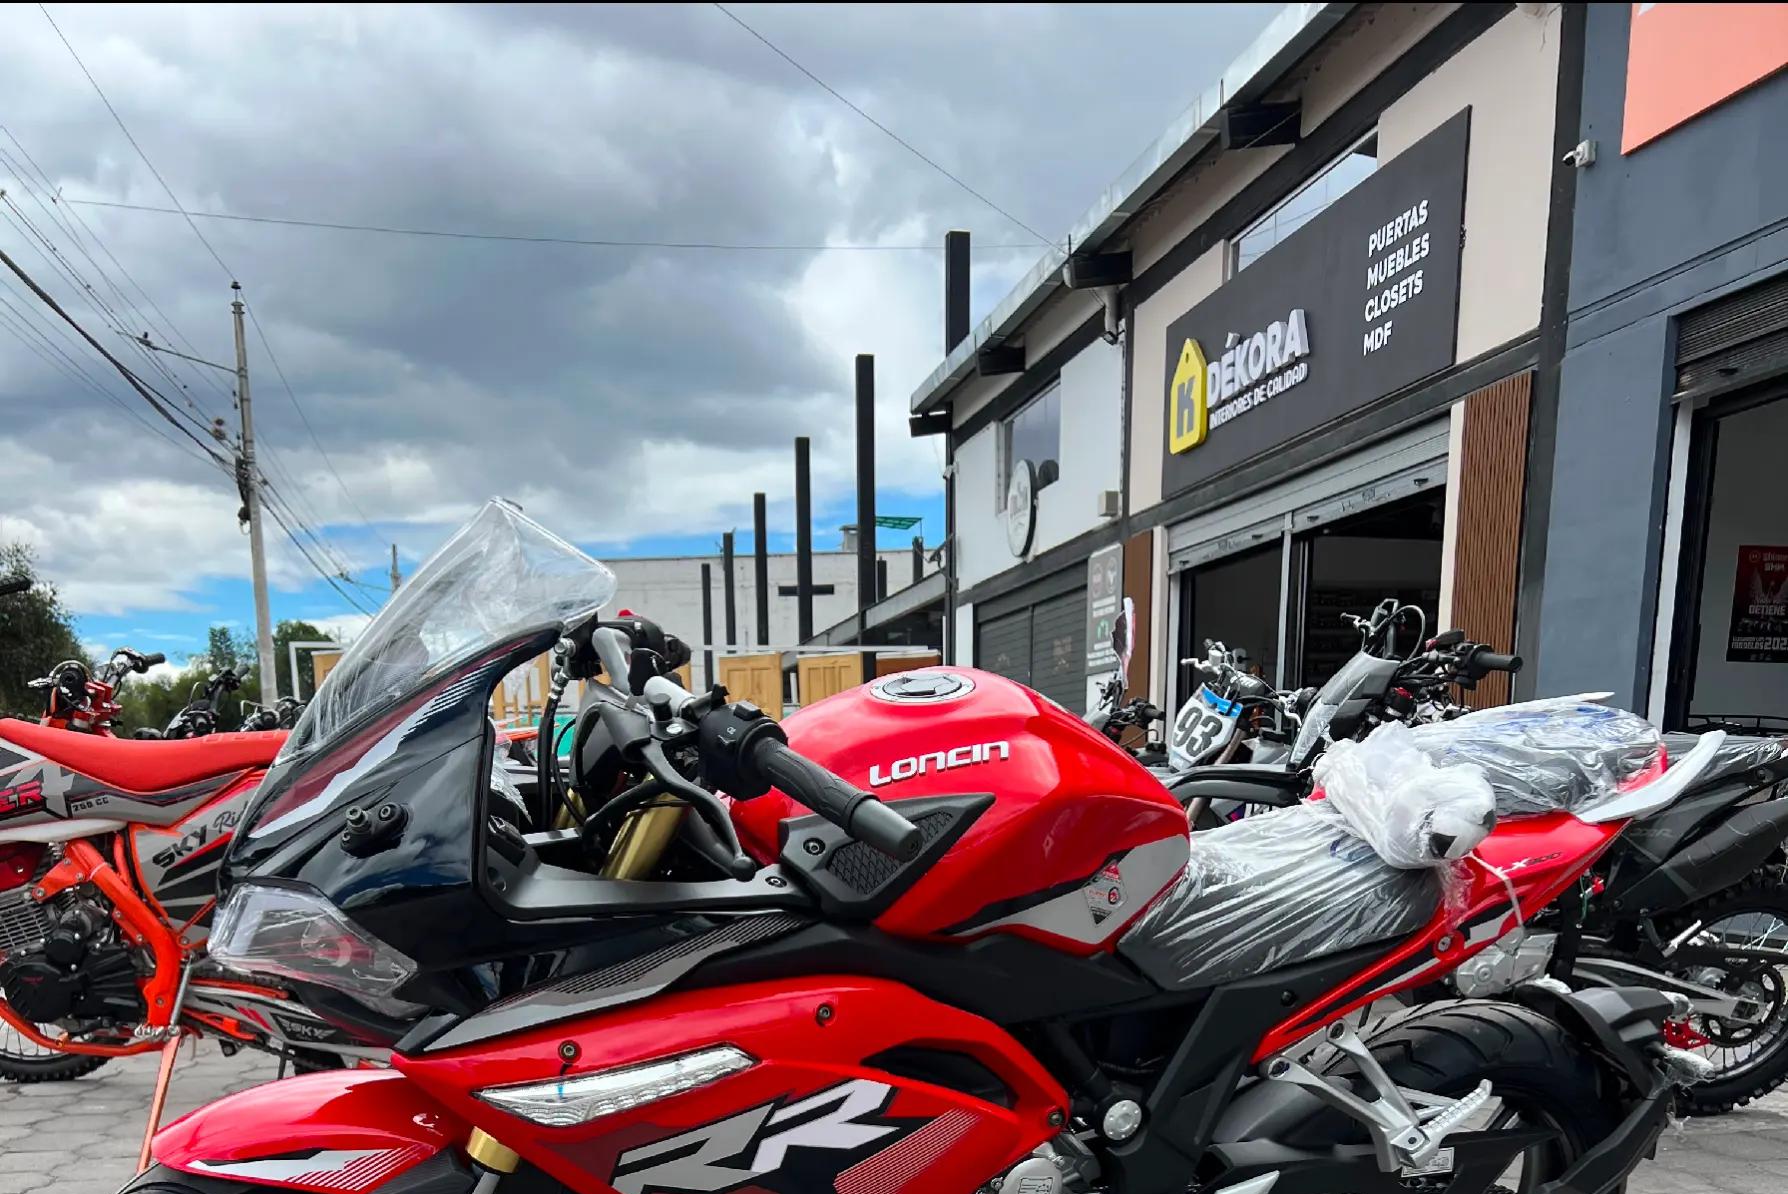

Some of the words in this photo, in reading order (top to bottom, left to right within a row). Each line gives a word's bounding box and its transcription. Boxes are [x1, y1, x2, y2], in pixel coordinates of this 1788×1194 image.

[1368, 199, 1429, 258] PUERTAS
[1366, 232, 1431, 290] MUEBLES
[1364, 269, 1424, 322] CLOSETS
[1206, 308, 1310, 409] DÉKORA
[1363, 320, 1393, 356] MDF
[1176, 375, 1197, 440] K
[1208, 392, 1254, 430] INTERIORES
[1253, 383, 1268, 406] DE
[1266, 362, 1308, 399] CALIDAD
[1172, 706, 1223, 758] 93
[152, 824, 208, 869] SKY
